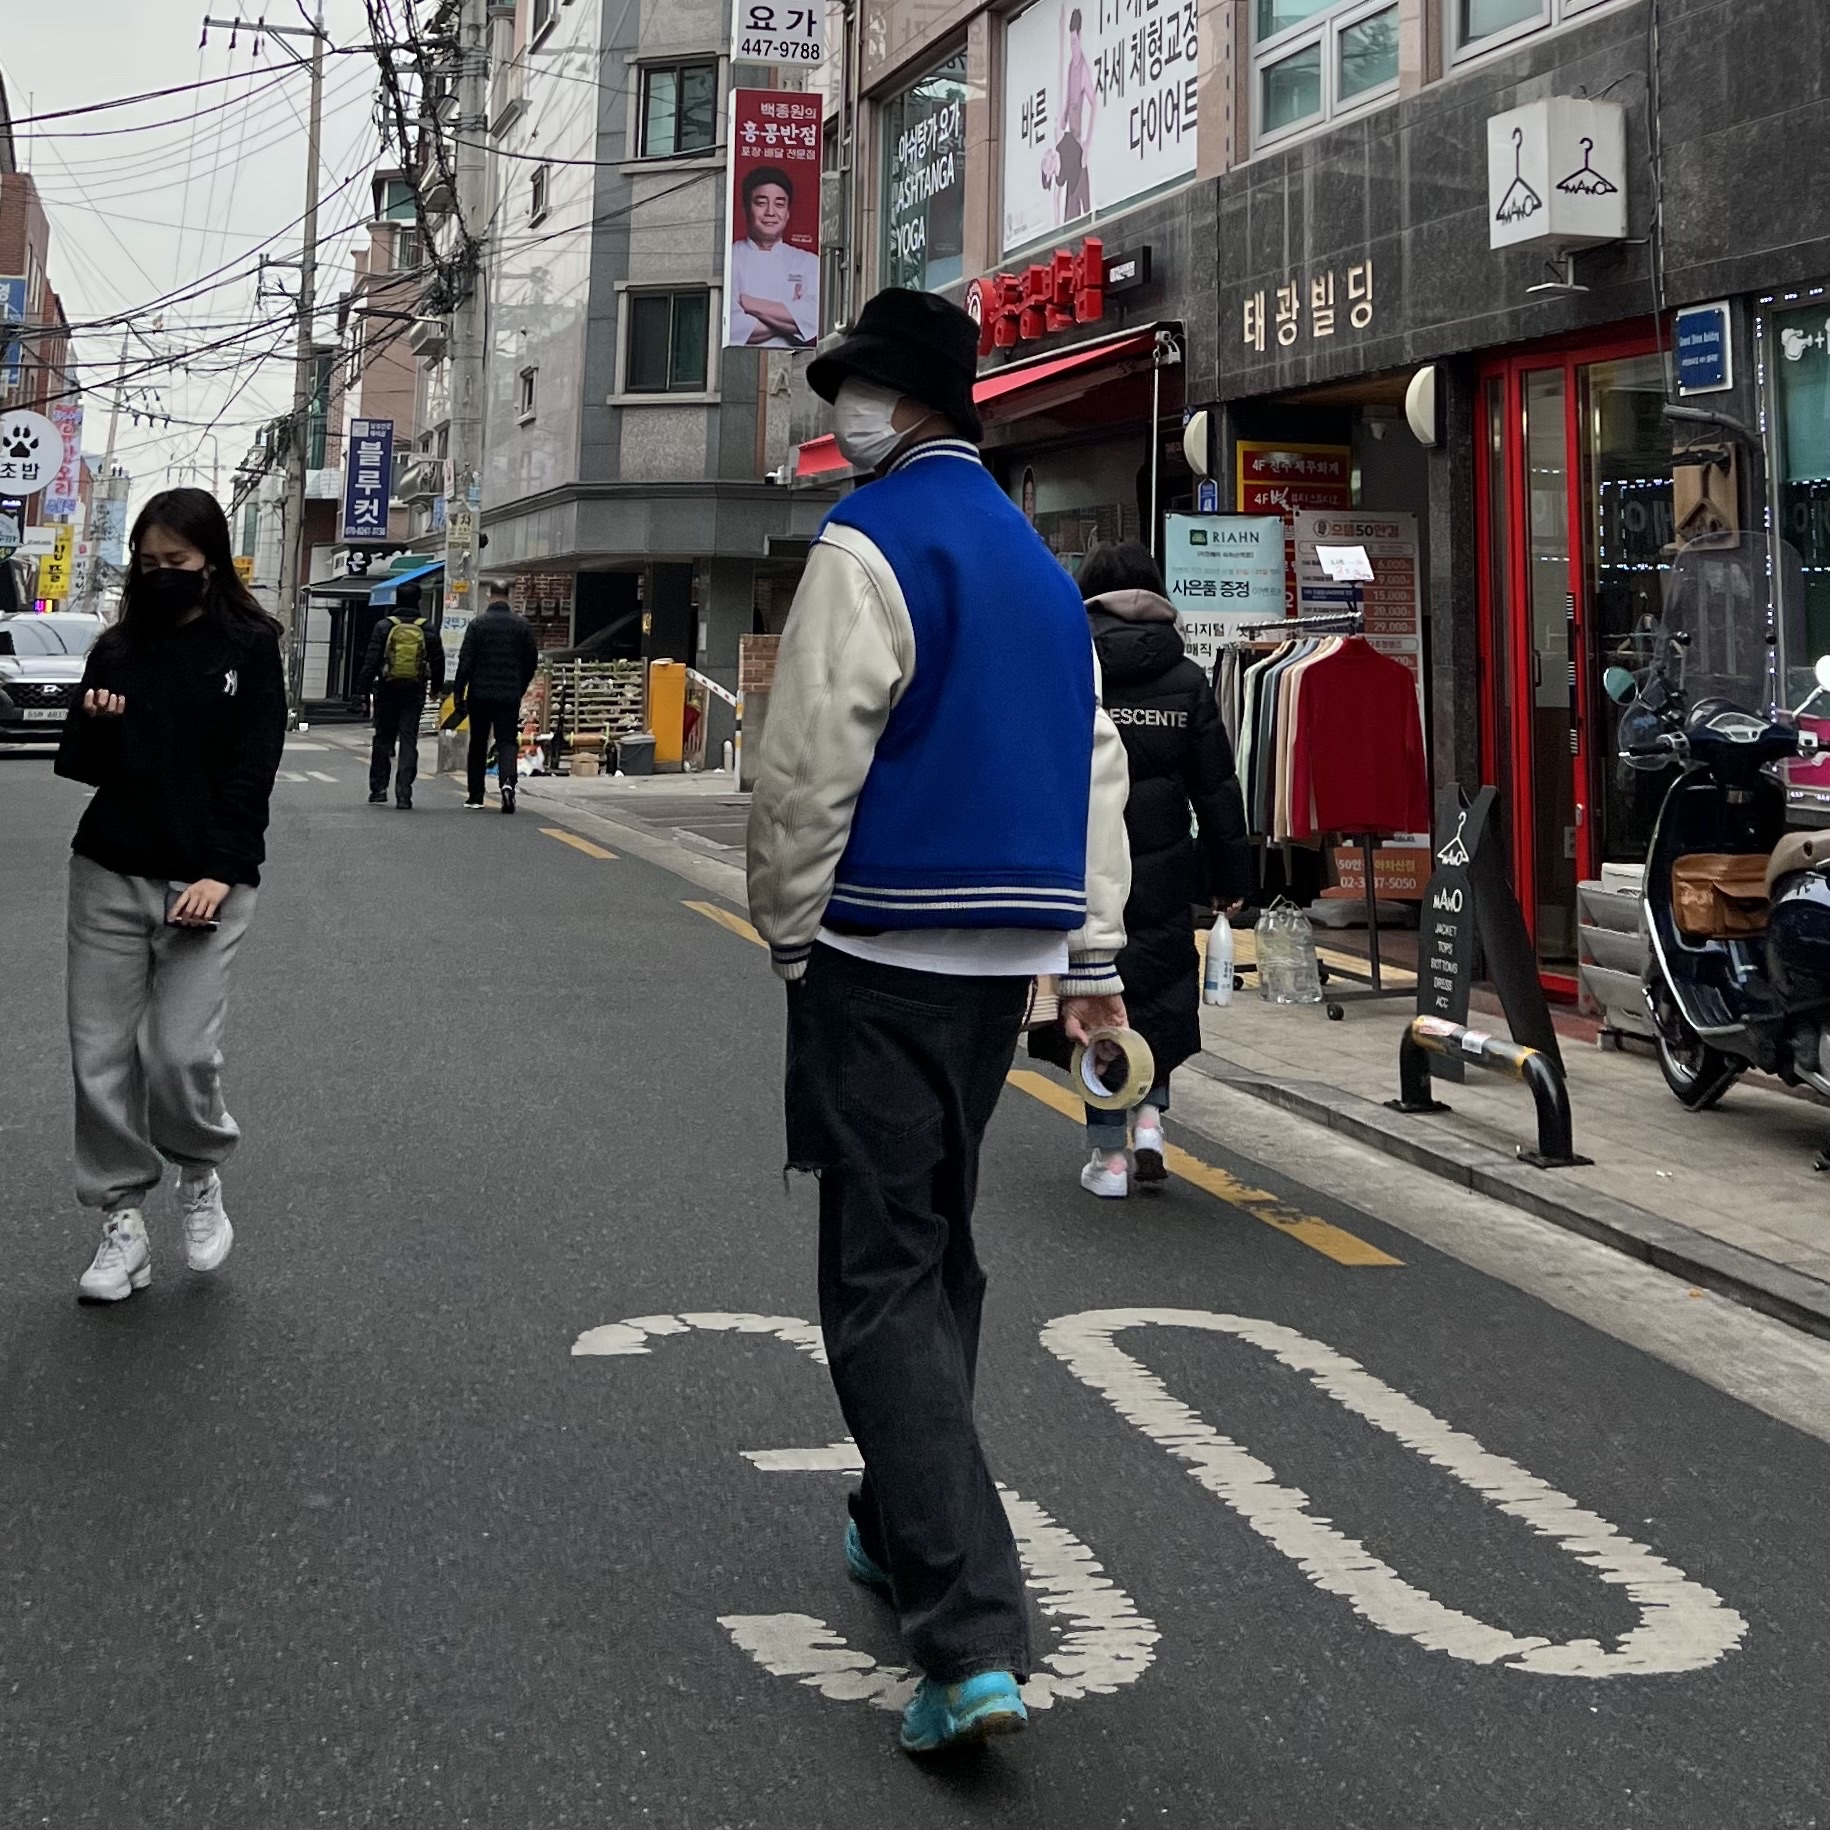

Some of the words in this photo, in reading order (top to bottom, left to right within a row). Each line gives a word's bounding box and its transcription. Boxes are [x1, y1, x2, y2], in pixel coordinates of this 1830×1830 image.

[745, 5, 817, 37] 요가
[741, 38, 820, 60] 447-9788
[1093, 38, 1126, 107] 자세
[760, 102, 816, 120] 백종원의
[1021, 87, 1048, 149] 바른
[1129, 76, 1198, 160] 다이어트
[740, 120, 816, 146] 홍콩반점
[899, 112, 938, 167] 아쉬탕가
[938, 98, 961, 146] 요가
[786, 149, 816, 160] 전문점
[896, 151, 956, 213] ASHTANGA
[896, 216, 925, 258] YOGA
[1243, 258, 1373, 352] 태광빌딩
[0, 462, 41, 480] 초밥
[354, 440, 384, 525] 블루컷
[1254, 493, 1269, 505] 4F
[1213, 531, 1260, 544] RIAHN
[1173, 579, 1217, 597] 사은품
[1220, 580, 1250, 598] 증정
[1185, 623, 1224, 637] 디지털
[1186, 643, 1212, 657] 매직
[1105, 707, 1188, 727] ESCENTE
[1374, 860, 1415, 872] 아차산점
[1432, 887, 1463, 913] MANO
[1434, 923, 1458, 937] JACKET
[1438, 941, 1453, 956] TOPS
[1430, 957, 1458, 974] BOTTOMS
[571, 1307, 1749, 1711] 30
